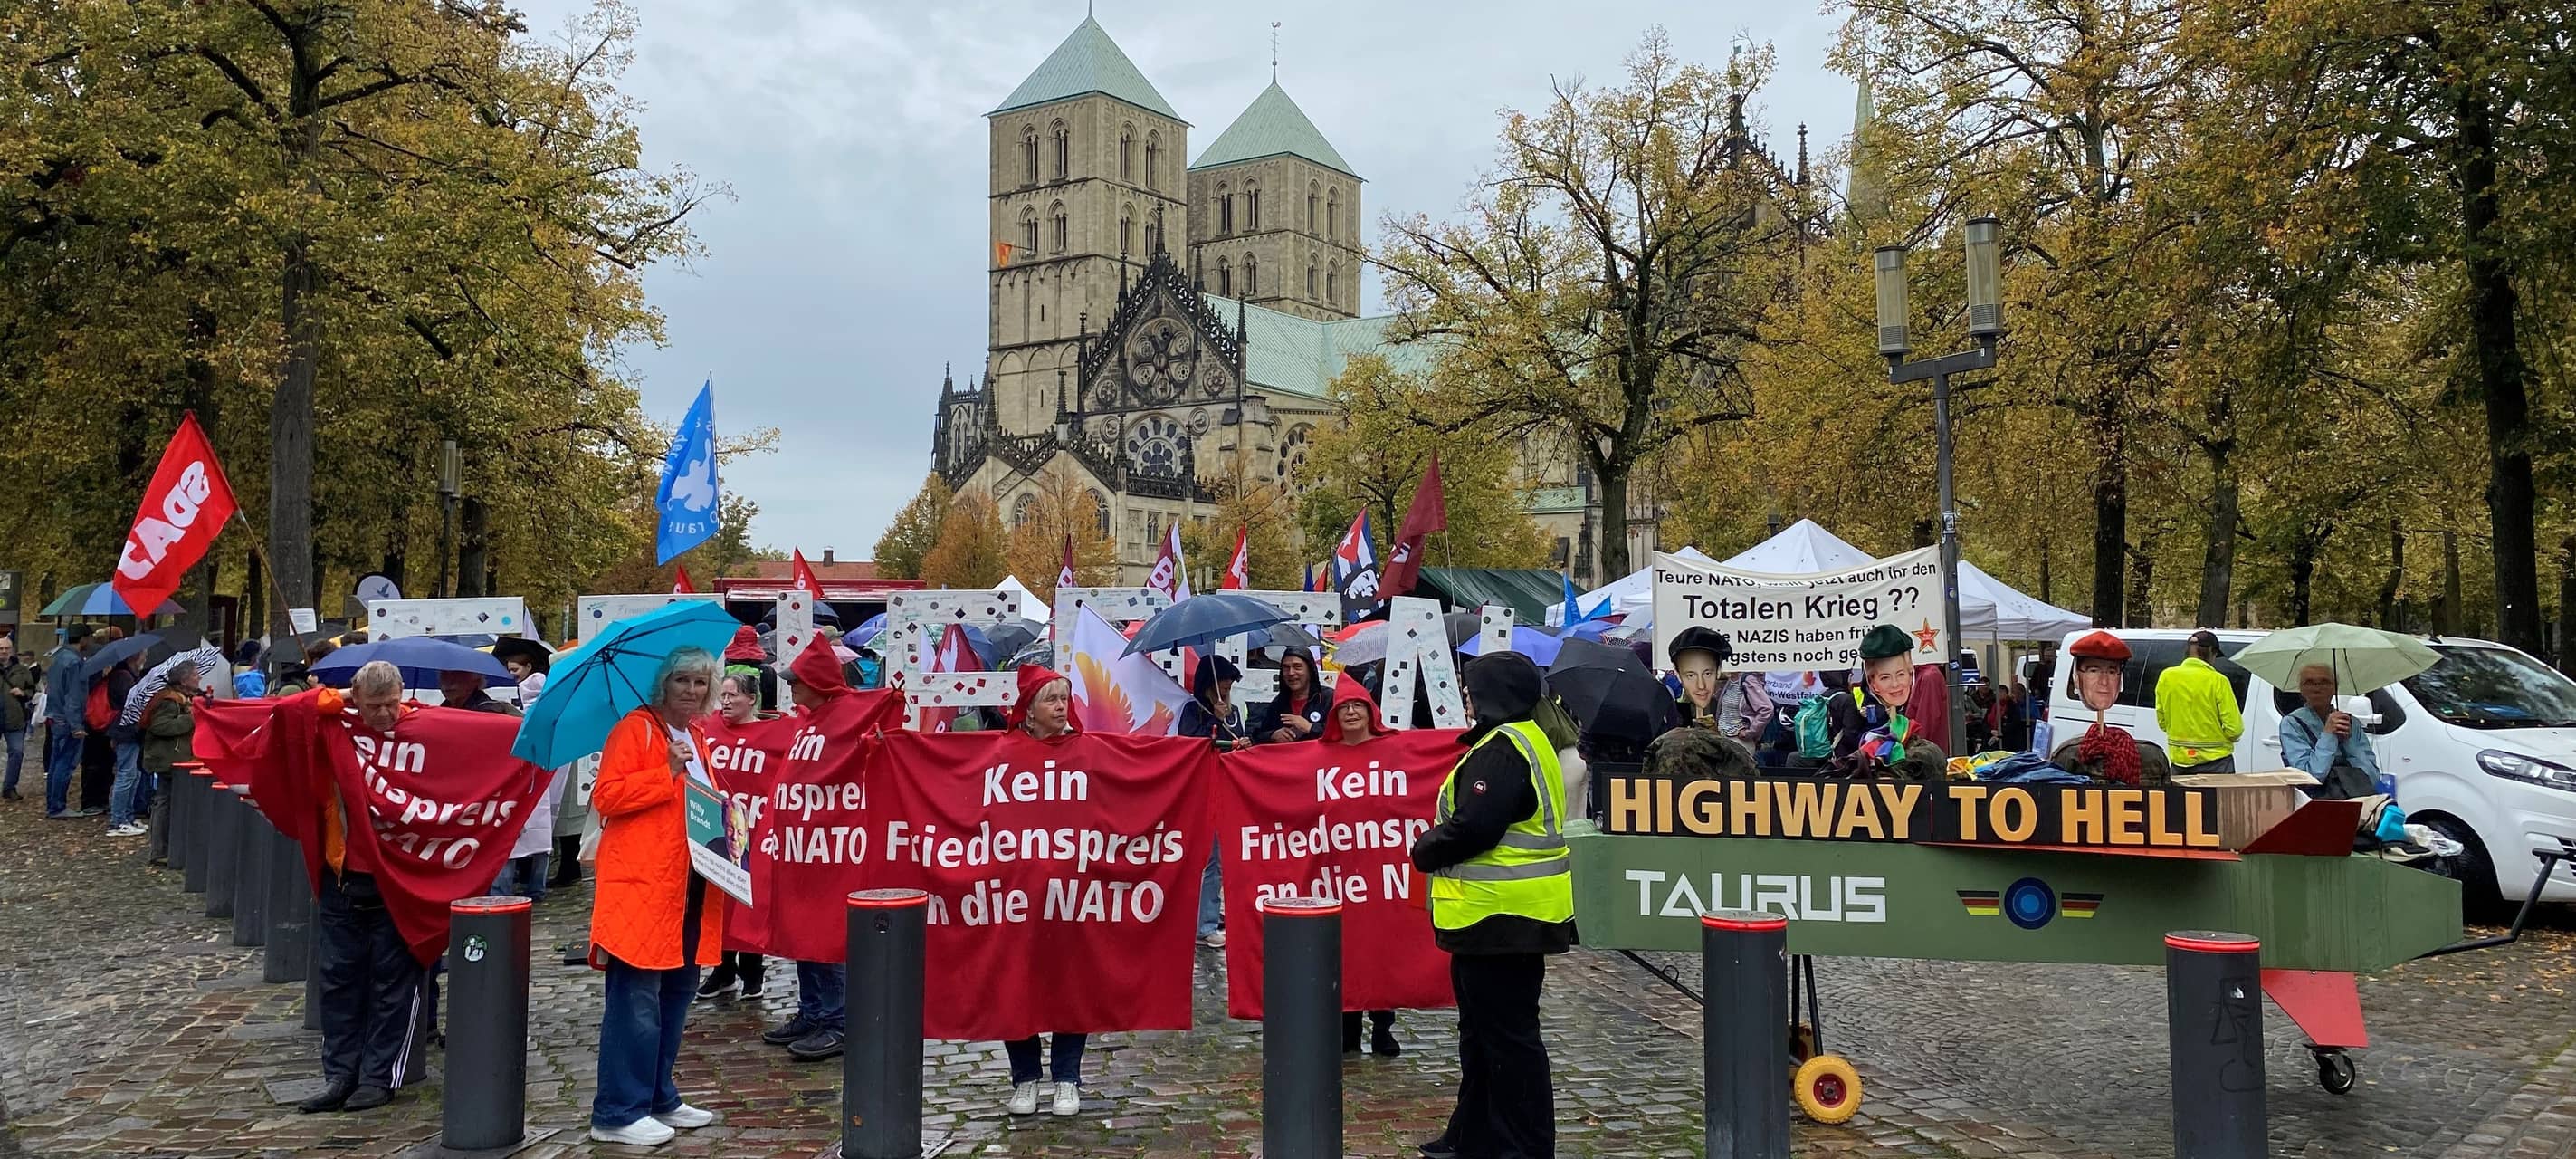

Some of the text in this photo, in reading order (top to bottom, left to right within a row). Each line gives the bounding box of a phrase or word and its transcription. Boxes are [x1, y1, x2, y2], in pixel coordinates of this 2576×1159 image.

[1655, 569, 1703, 585] Teure
[1709, 572, 1761, 589] NATO,
[1848, 568, 1884, 583] auch
[1888, 566, 1908, 580] ihr
[1912, 562, 1936, 576] den
[1682, 586, 1920, 620] Totalen Krieg ??
[1737, 629, 1789, 644] NAZIS
[1795, 628, 1844, 643] haben
[1725, 650, 1787, 666] gstens
[1793, 647, 1833, 663] noch
[1765, 679, 1792, 689] erband
[353, 731, 425, 773] ein
[705, 737, 766, 774] ein
[983, 760, 1087, 807] Kein
[1316, 761, 1407, 802] Kein
[689, 799, 705, 817] Willy
[690, 810, 711, 830] Brandt
[1609, 777, 2220, 847] HIGHWAY TO HELL
[381, 831, 480, 870] ATO
[784, 826, 867, 865] NATO
[886, 820, 1184, 873] Friedenspreis
[1241, 814, 1430, 860] Friedensp
[927, 878, 1164, 926] n die NATO
[1255, 881, 1299, 912] an
[1311, 865, 1368, 905] die
[1625, 868, 1886, 924] TAURUS
